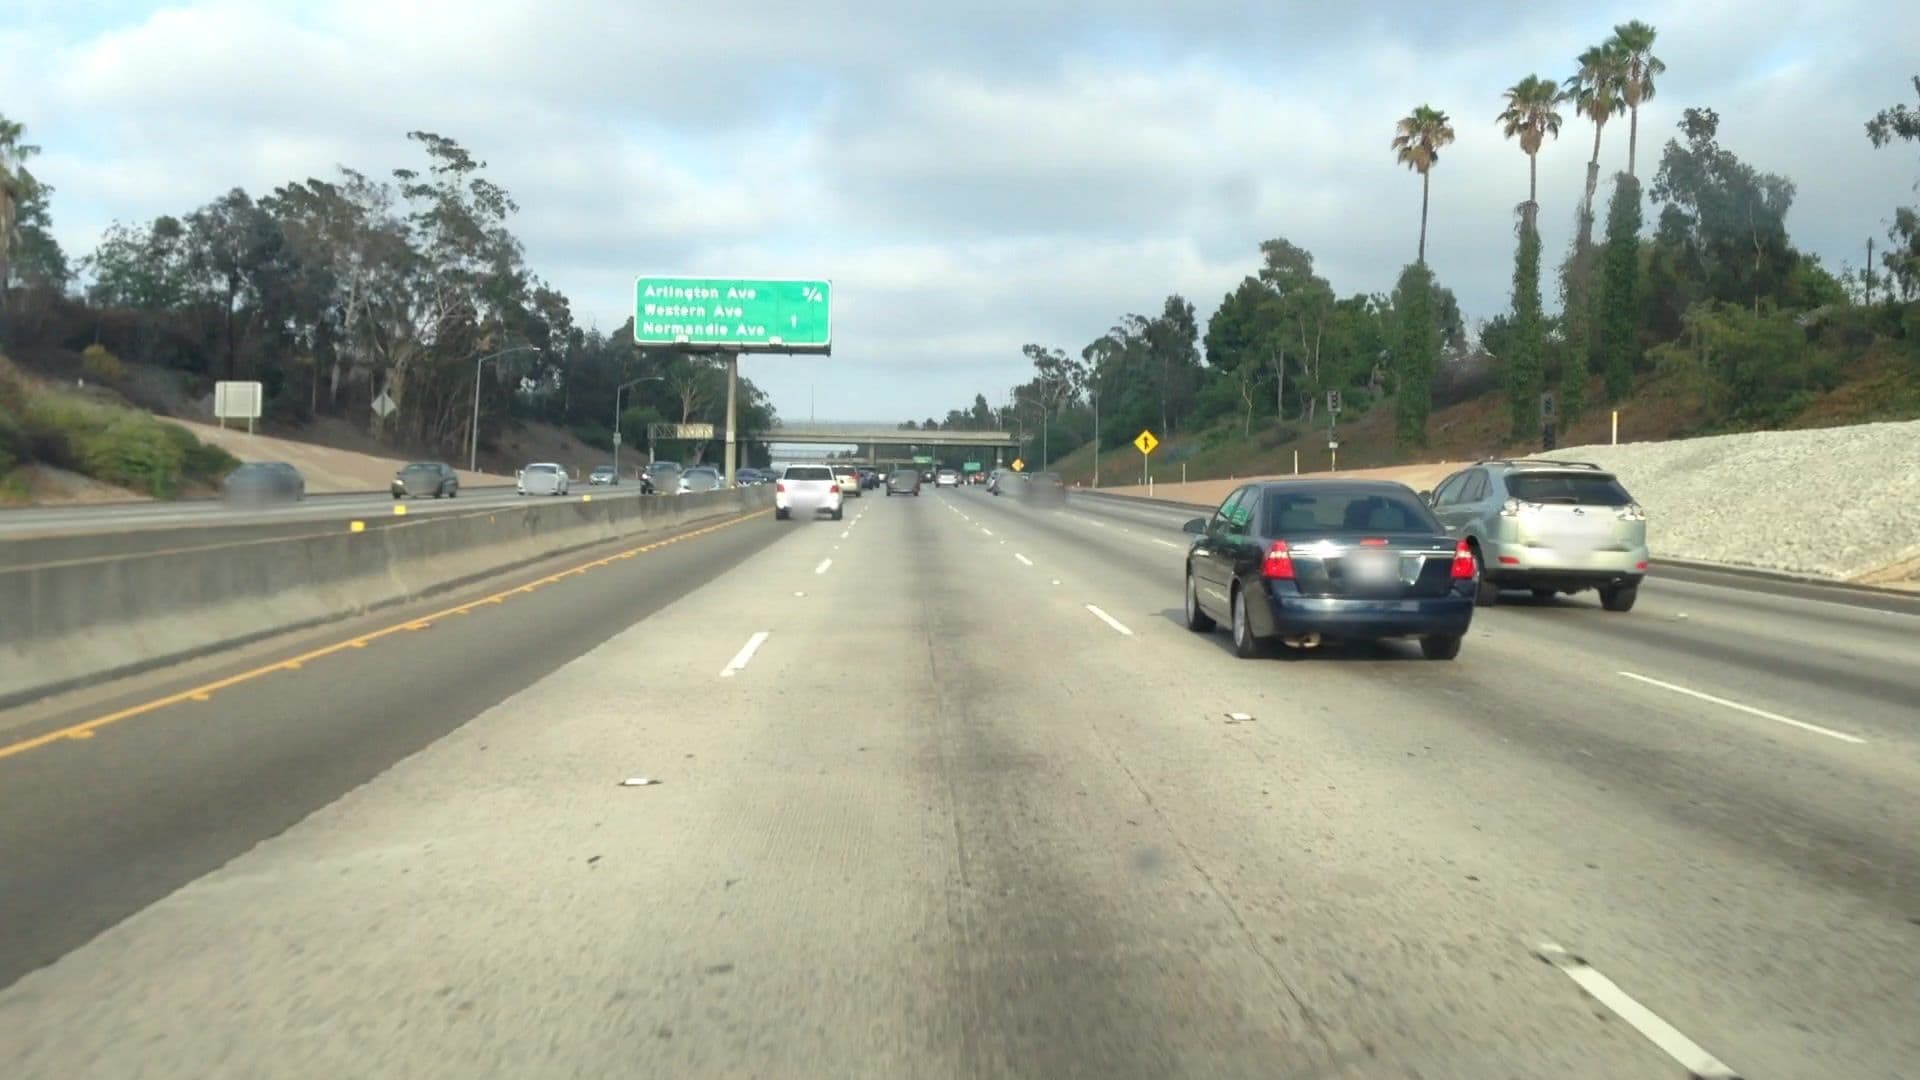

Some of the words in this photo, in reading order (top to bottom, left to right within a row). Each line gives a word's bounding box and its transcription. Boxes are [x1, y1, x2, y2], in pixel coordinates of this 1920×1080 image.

[645, 285, 719, 303] Arlington
[727, 285, 757, 300] Ave
[644, 304, 706, 317] Western
[714, 305, 743, 318] Ave
[643, 321, 728, 336] Normandie
[736, 323, 765, 337] Ave
